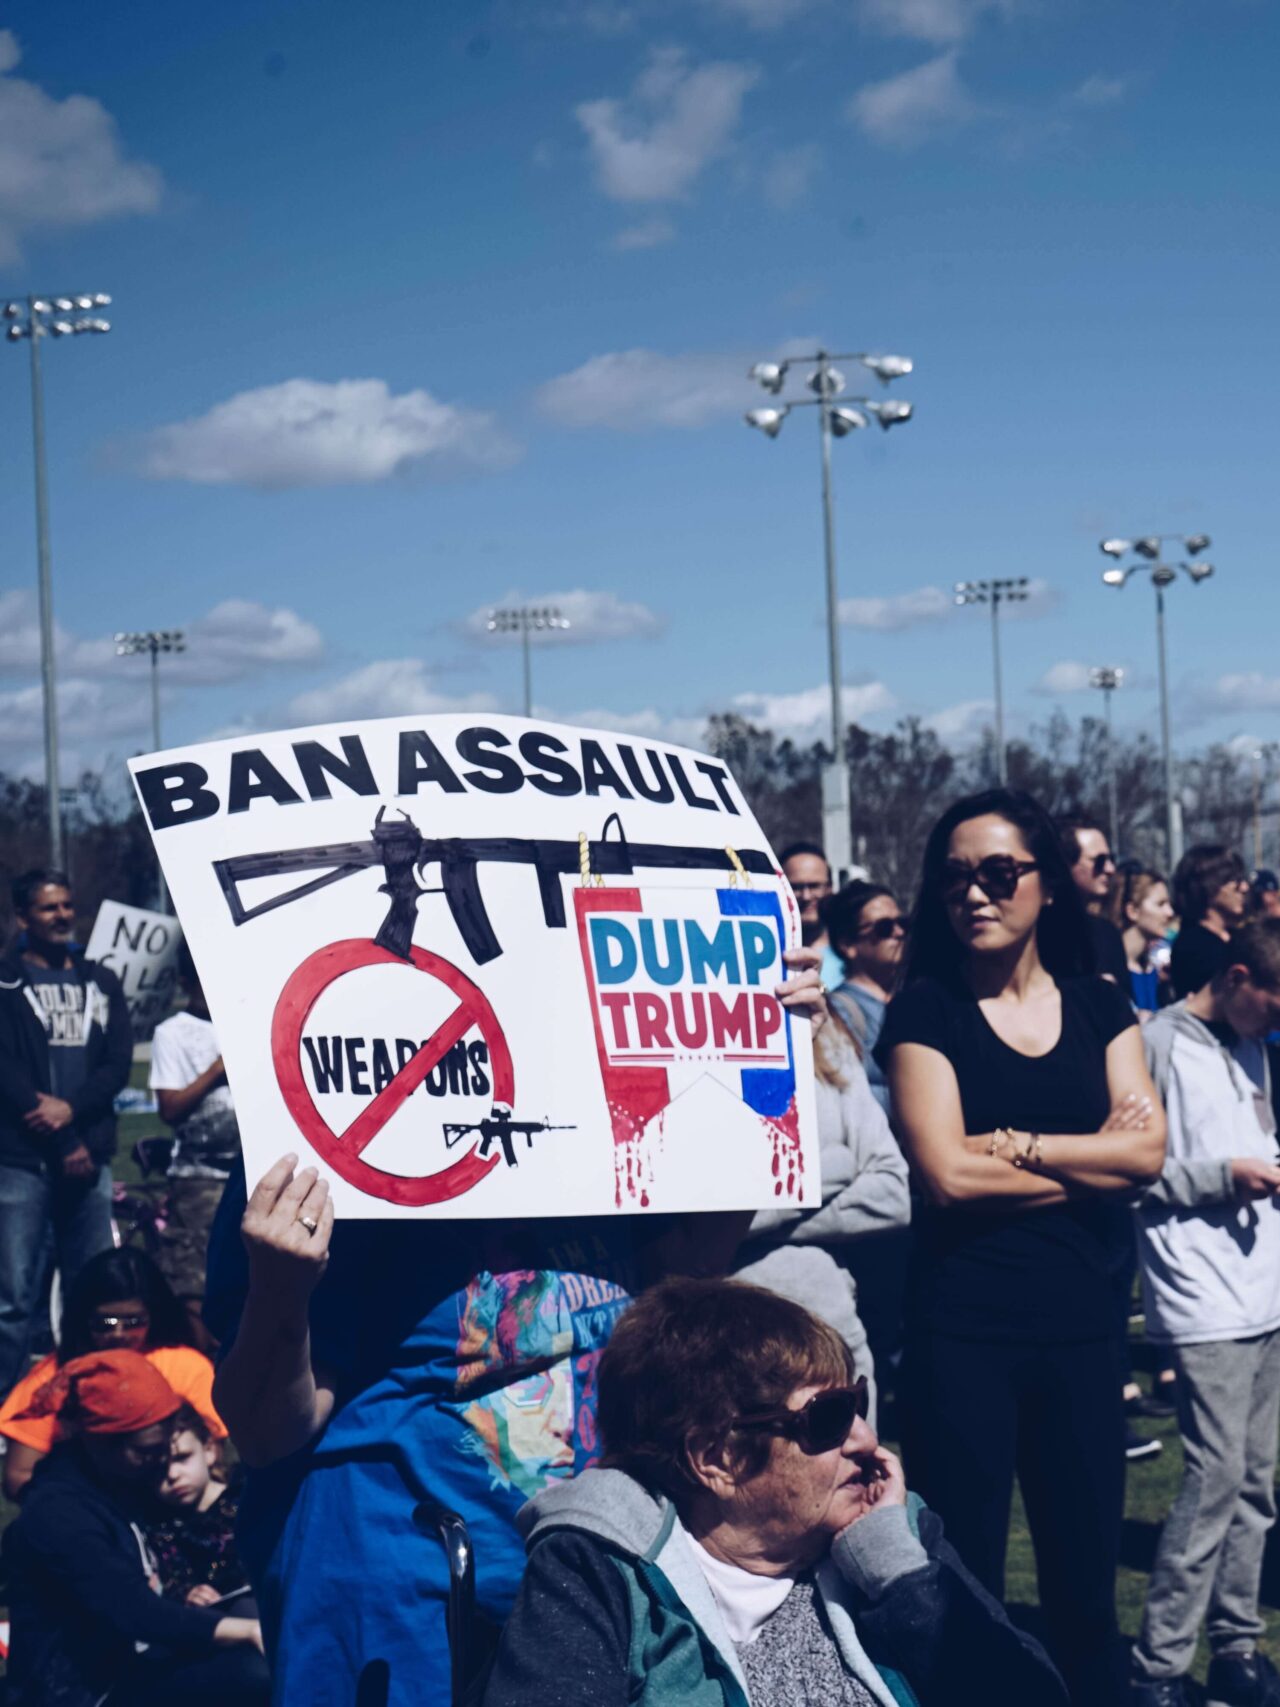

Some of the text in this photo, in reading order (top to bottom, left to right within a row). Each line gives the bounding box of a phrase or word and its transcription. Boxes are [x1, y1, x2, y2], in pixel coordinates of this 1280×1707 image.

[134, 726, 742, 831] BAN ASSAULT
[111, 914, 169, 956] NO
[589, 917, 778, 986] DUMP
[600, 991, 782, 1050] TRUMP
